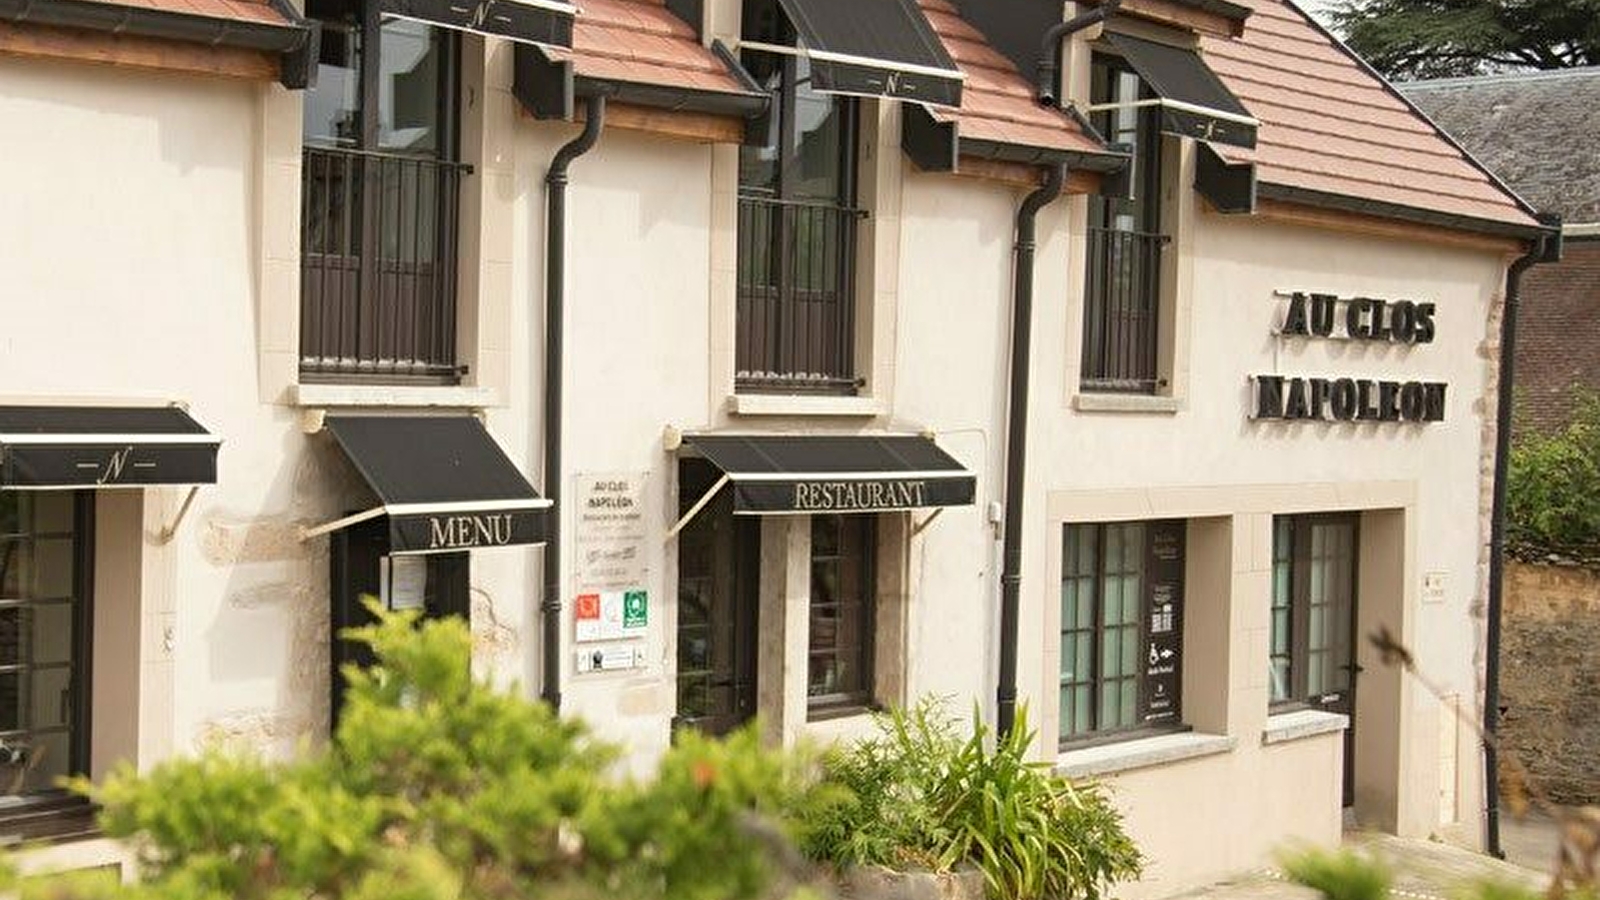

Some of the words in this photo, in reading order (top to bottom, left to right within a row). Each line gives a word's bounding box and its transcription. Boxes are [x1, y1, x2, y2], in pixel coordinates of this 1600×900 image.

[1281, 291, 1338, 336] AU
[1346, 297, 1436, 343] CLOS
[1256, 375, 1448, 422] NAPOLEON
[794, 480, 925, 510] RESTAURANT
[430, 514, 512, 549] MENU
